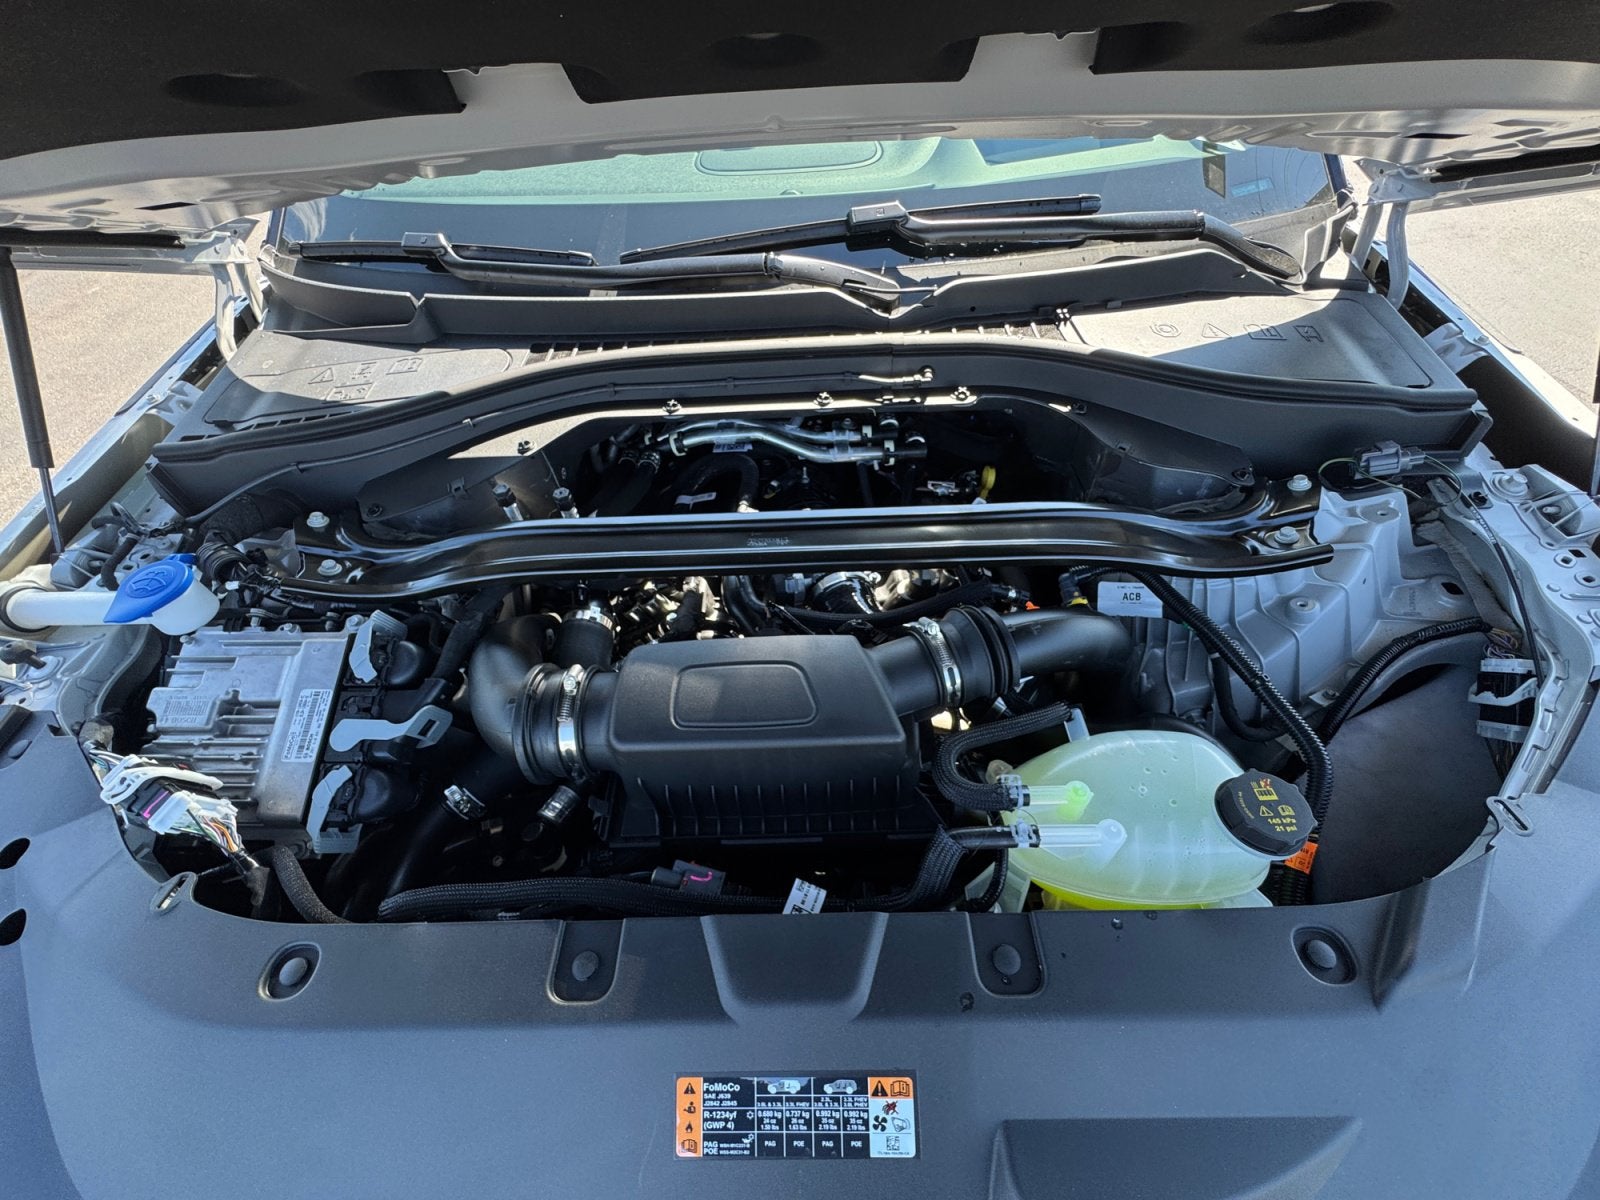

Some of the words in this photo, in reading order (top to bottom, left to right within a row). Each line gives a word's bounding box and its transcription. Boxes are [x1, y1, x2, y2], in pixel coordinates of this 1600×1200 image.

[1122, 592, 1142, 601] ACB
[704, 1083, 740, 1091] FoMoCo
[704, 1111, 737, 1120] R-1234yf
[704, 1121, 725, 1130] (GWP
[727, 1121, 734, 1130] 4)
